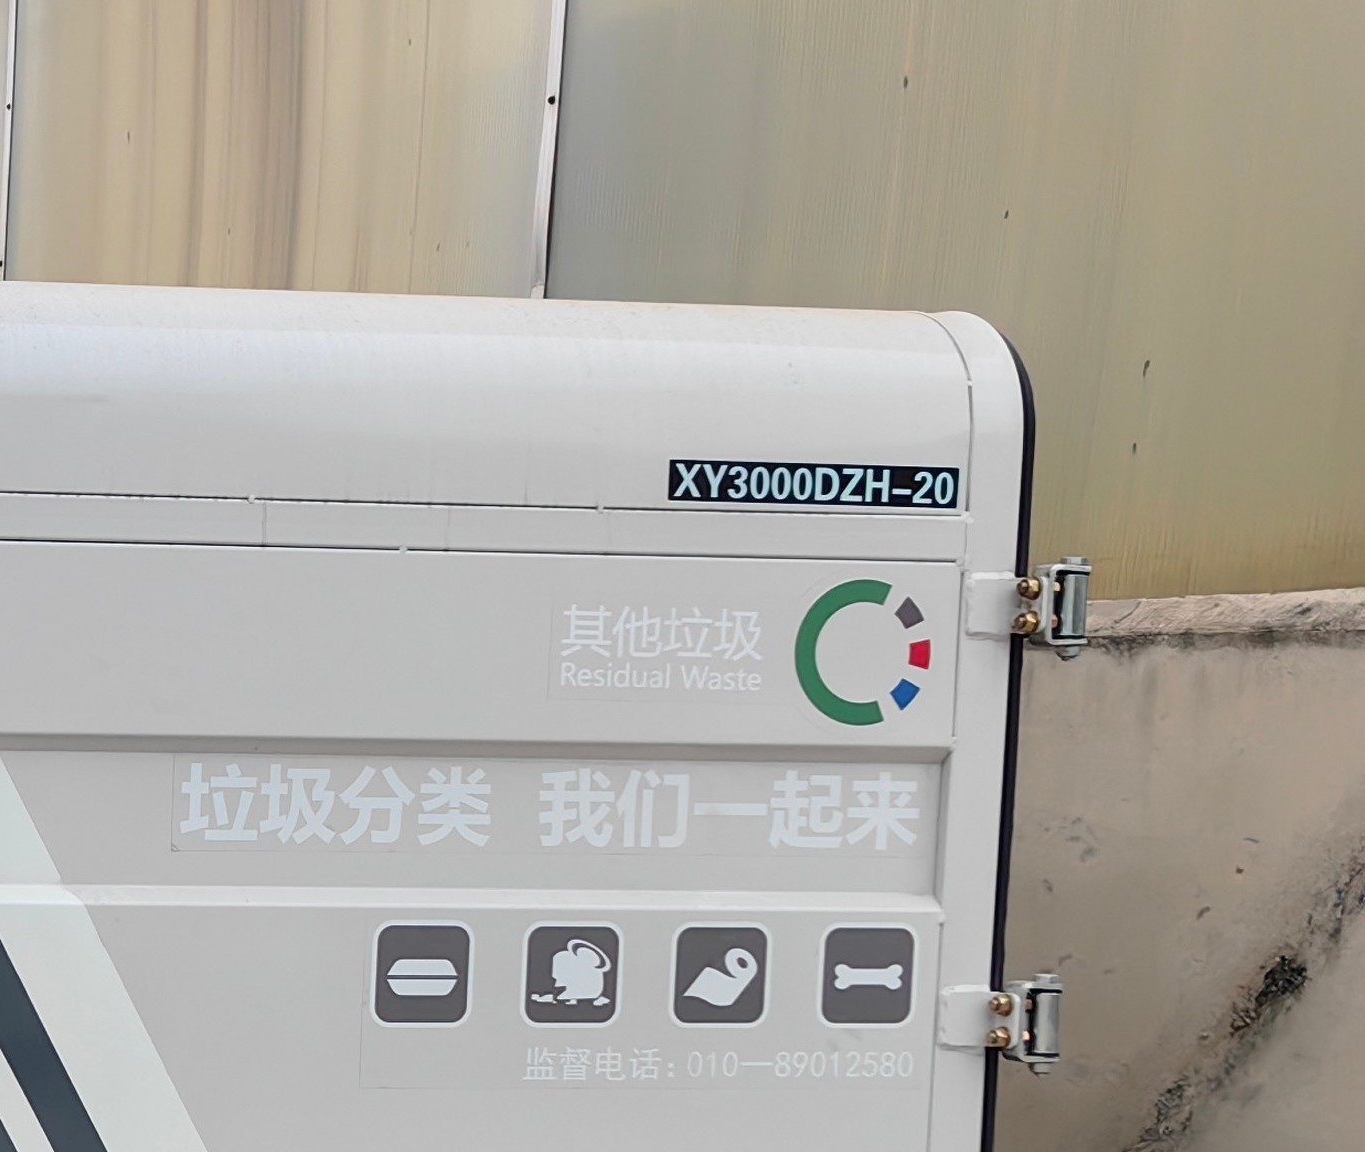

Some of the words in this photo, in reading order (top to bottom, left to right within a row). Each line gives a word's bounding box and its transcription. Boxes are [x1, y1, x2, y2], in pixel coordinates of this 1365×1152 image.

[673, 463, 955, 505] XY3000DZH-20
[560, 604, 763, 661] 其他垃圾
[560, 662, 670, 689] Residual
[680, 664, 762, 691] Waste
[180, 763, 491, 847] 垃圾分类
[539, 769, 919, 851] 我们一起来
